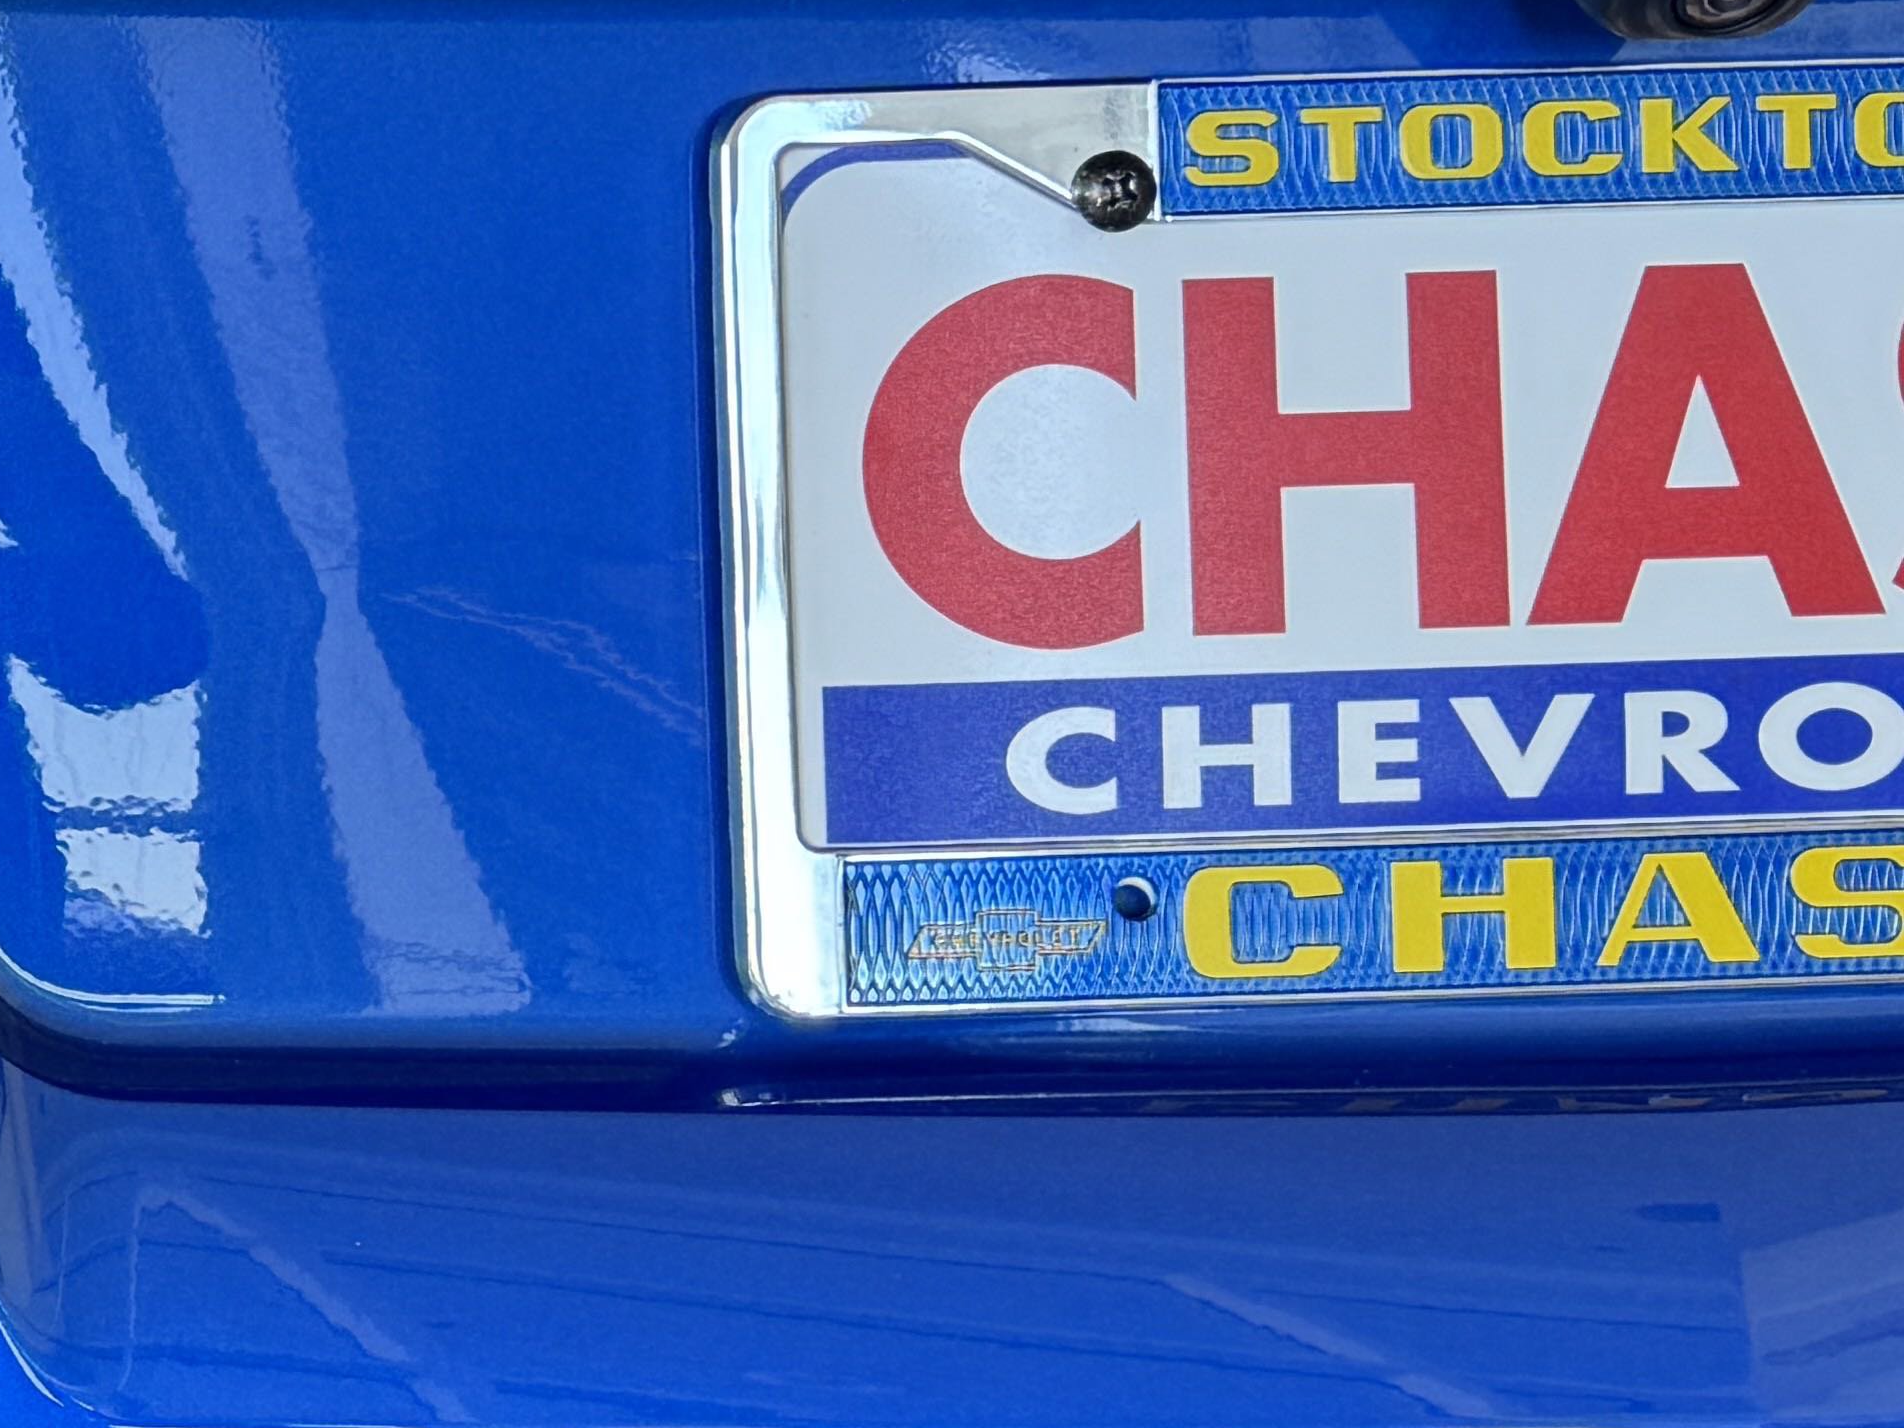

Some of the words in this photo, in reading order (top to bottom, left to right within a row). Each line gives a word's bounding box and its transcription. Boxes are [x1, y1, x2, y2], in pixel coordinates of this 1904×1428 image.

[861, 262, 1904, 650] CHA
[1004, 682, 1904, 813] CHEVRO
[1182, 843, 1904, 980] CHAS
